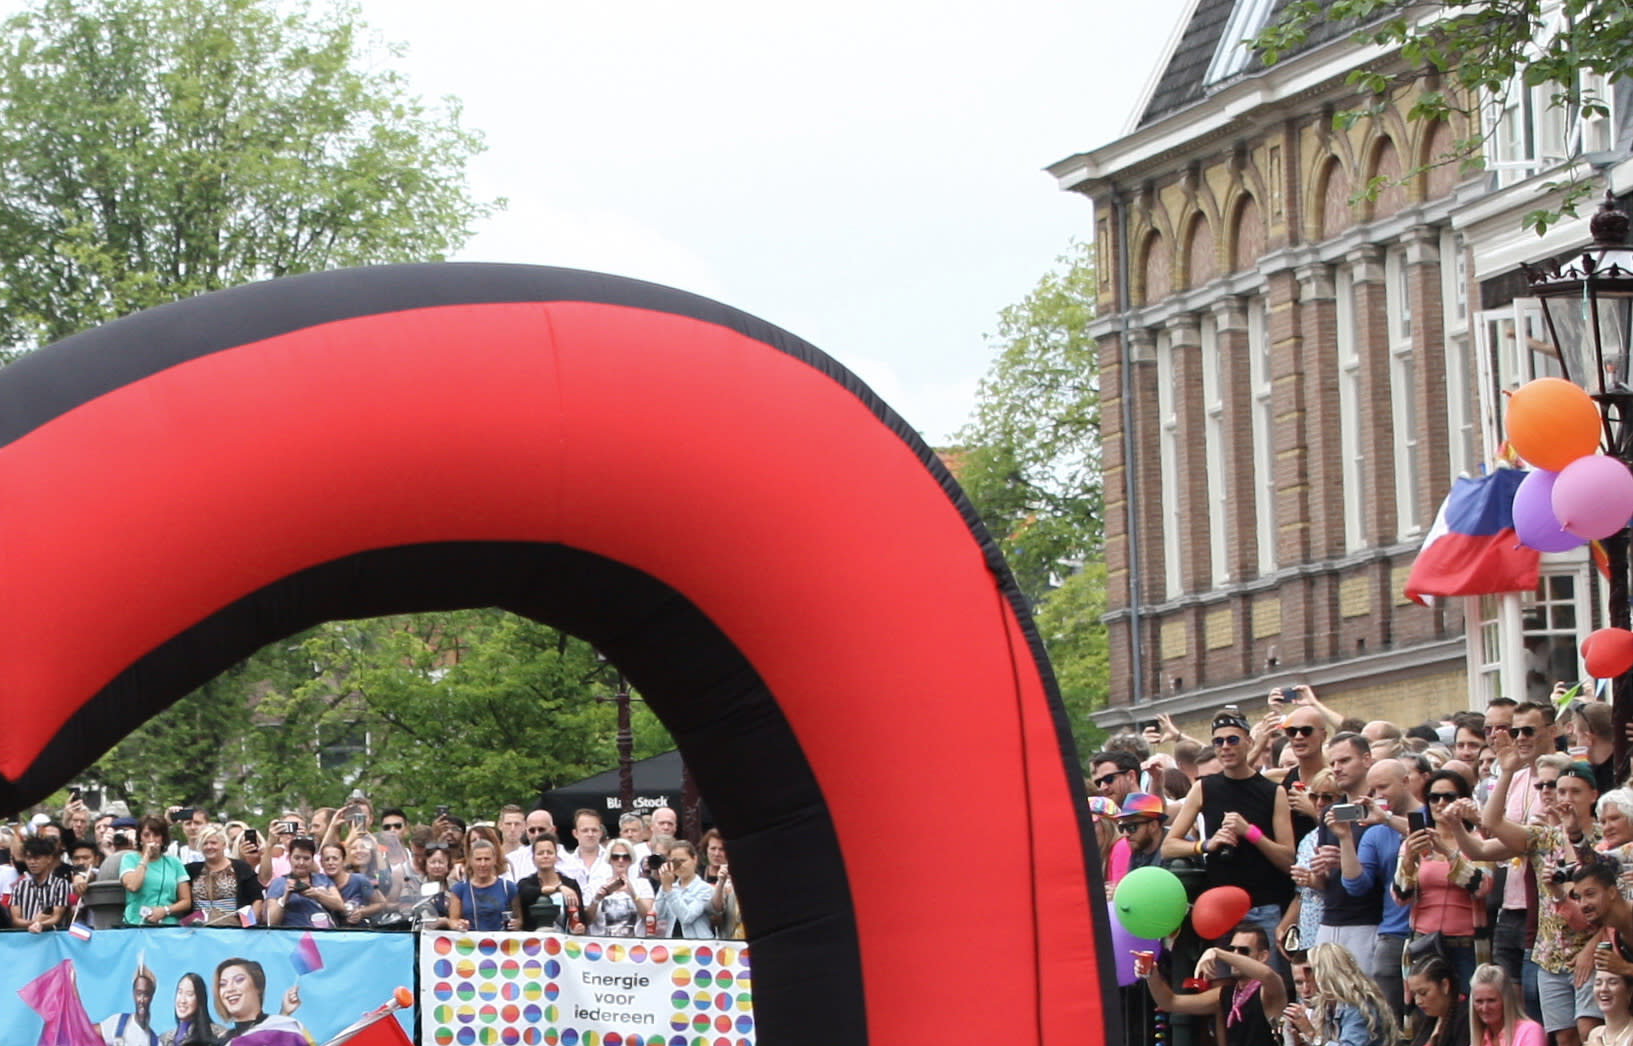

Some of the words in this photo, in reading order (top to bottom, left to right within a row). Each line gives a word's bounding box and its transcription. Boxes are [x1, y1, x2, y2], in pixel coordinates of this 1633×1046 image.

[581, 971, 650, 990] Energie
[594, 992, 635, 1006] voor
[574, 1004, 655, 1025] iedereen
